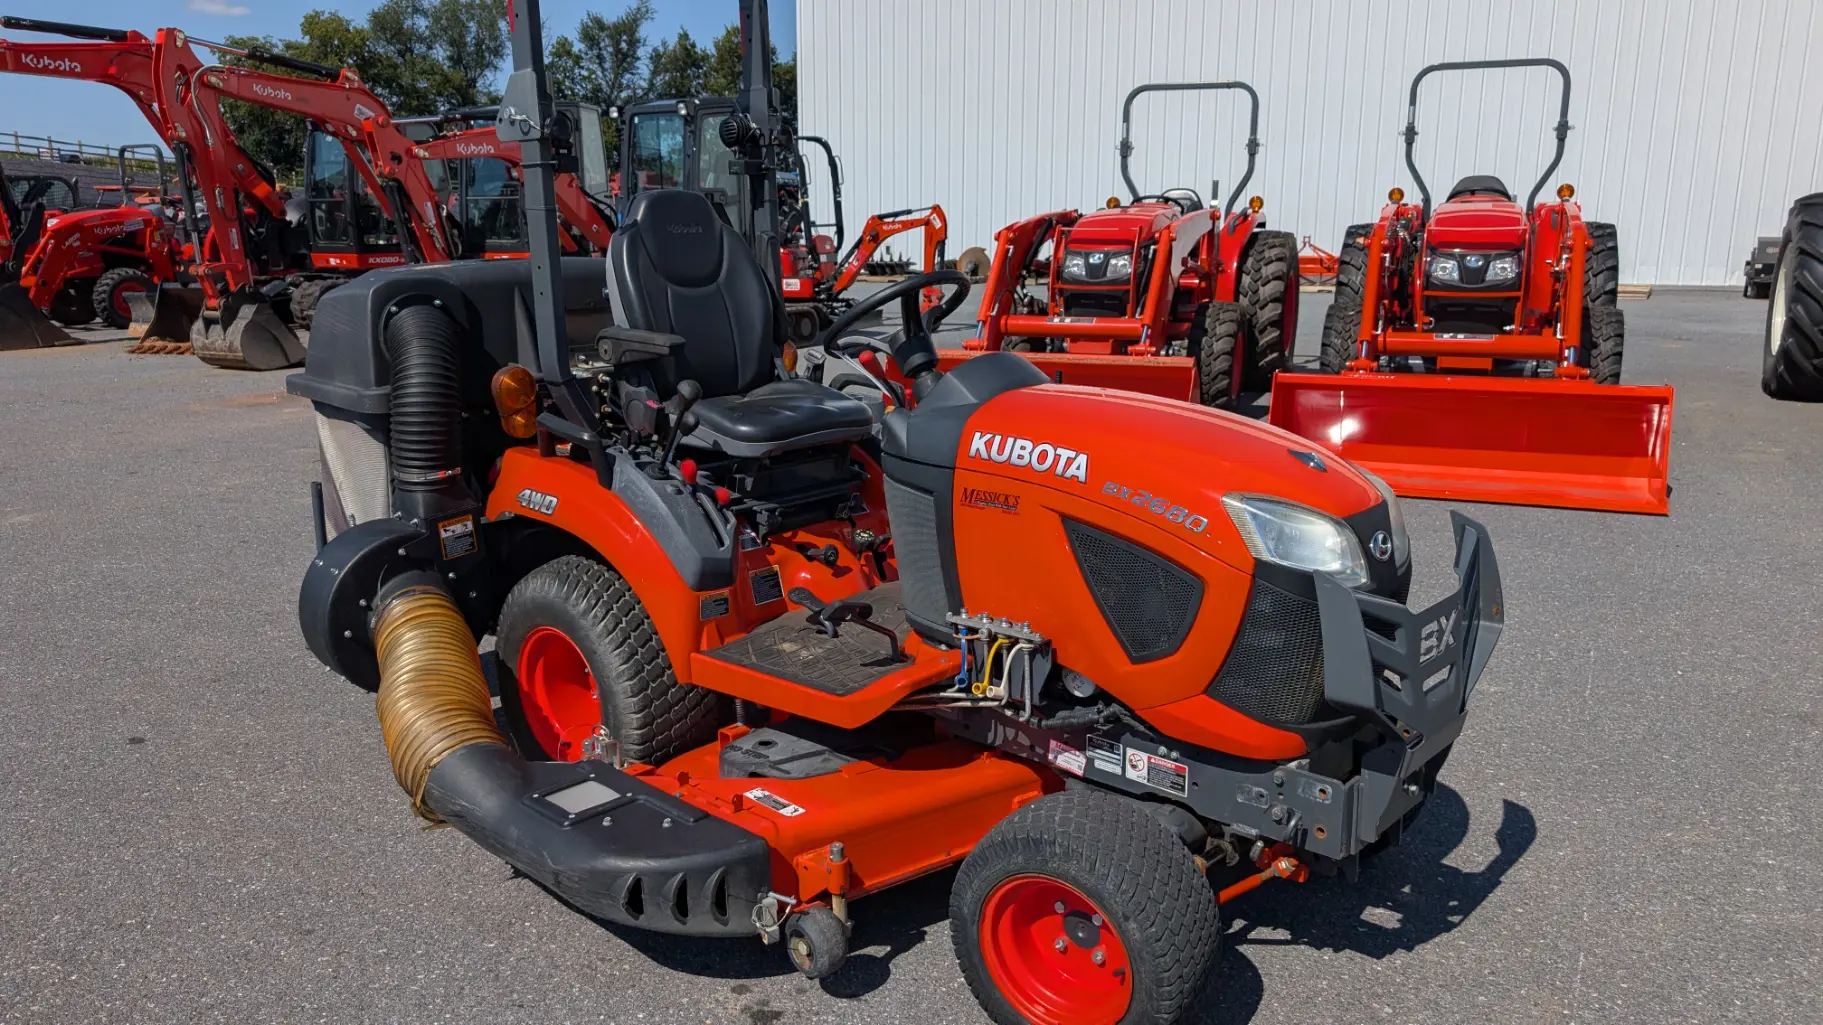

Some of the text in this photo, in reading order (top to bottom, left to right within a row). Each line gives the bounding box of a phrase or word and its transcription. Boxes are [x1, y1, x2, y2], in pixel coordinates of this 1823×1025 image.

[21, 53, 81, 72] Kubota
[253, 83, 292, 101] Kubota
[456, 142, 495, 155] Kubota
[968, 431, 1088, 484] KUBOTA
[515, 488, 558, 515] 4WD
[960, 487, 1020, 506] MESSICK'S
[1101, 480, 1209, 533] BX2680
[1420, 609, 1458, 665] BX
